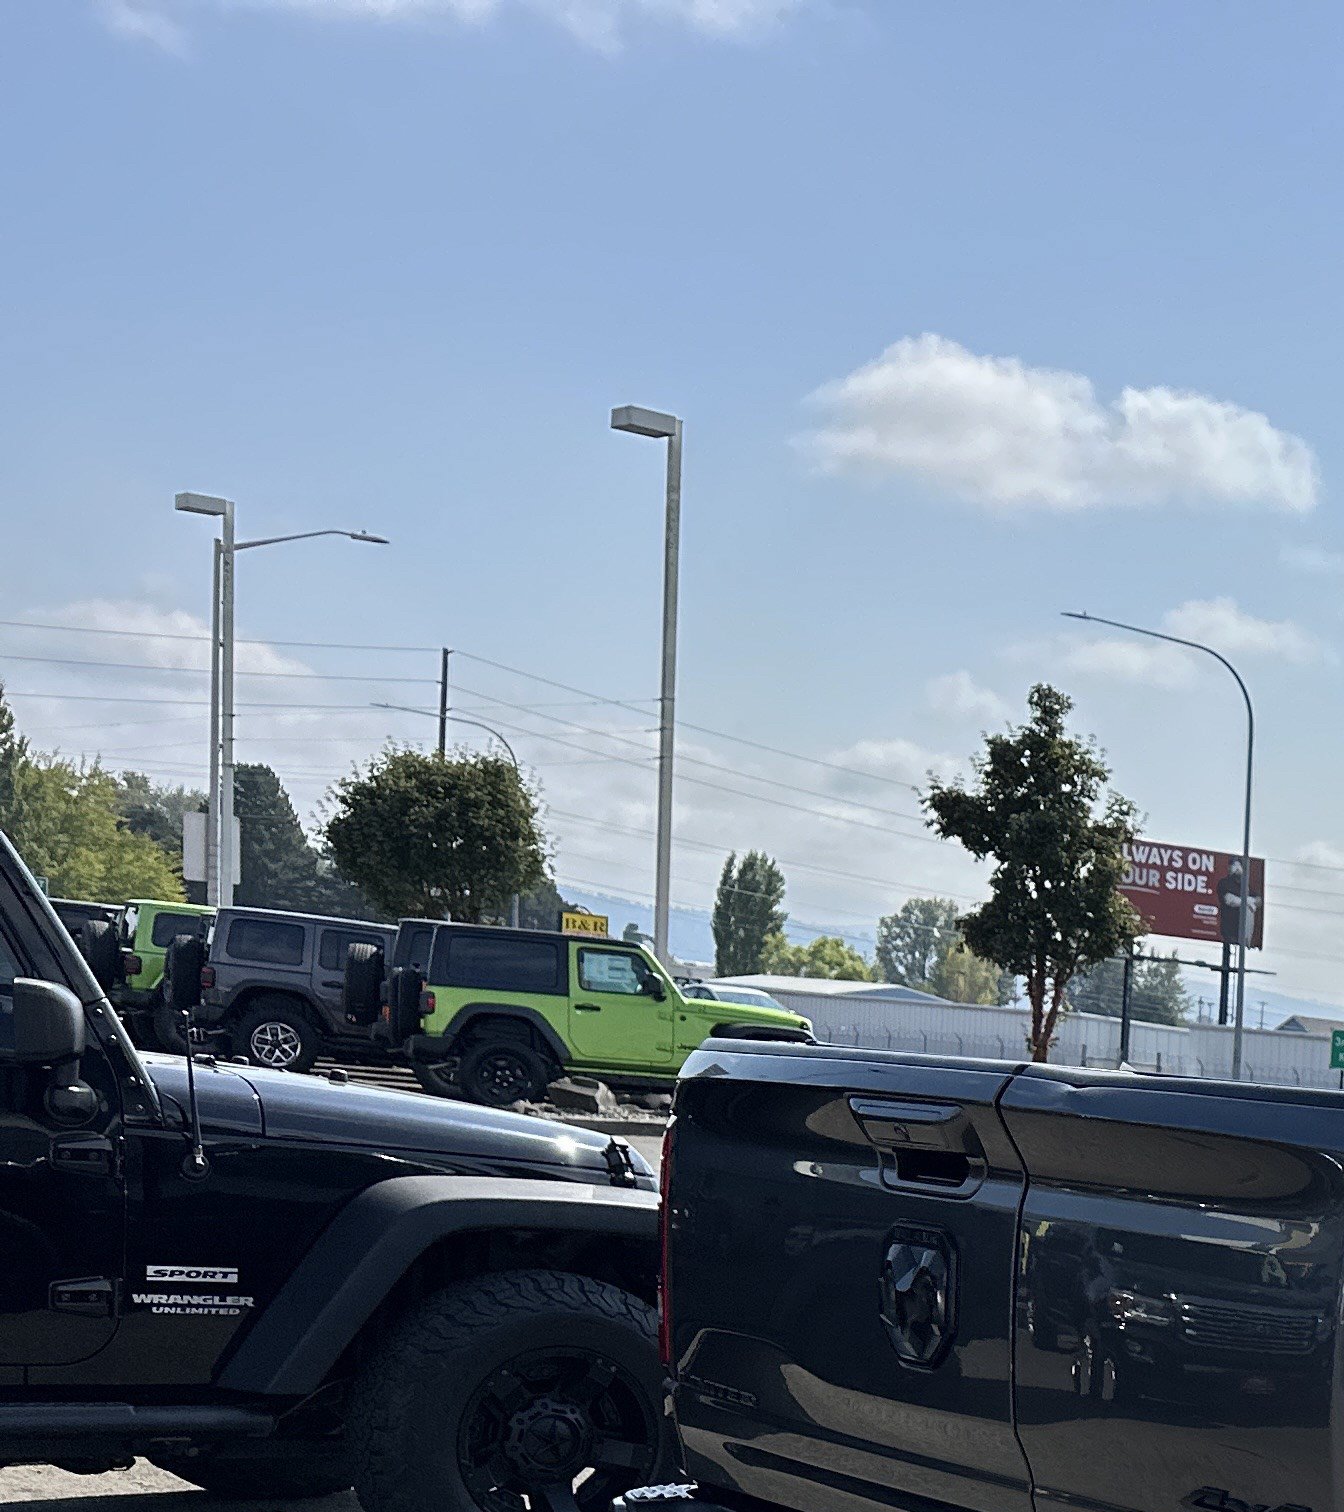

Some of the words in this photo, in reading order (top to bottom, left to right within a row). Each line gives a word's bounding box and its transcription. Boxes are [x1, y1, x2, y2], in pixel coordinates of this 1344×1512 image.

[1121, 843, 1183, 868] LWAYS
[1188, 851, 1215, 873] ON
[1121, 866, 1161, 888] OUR
[1165, 871, 1213, 895] SIDE.
[150, 1268, 235, 1280] SPORT
[132, 1293, 254, 1307] WRANGLER
[152, 1307, 240, 1315] UNLIMITED
